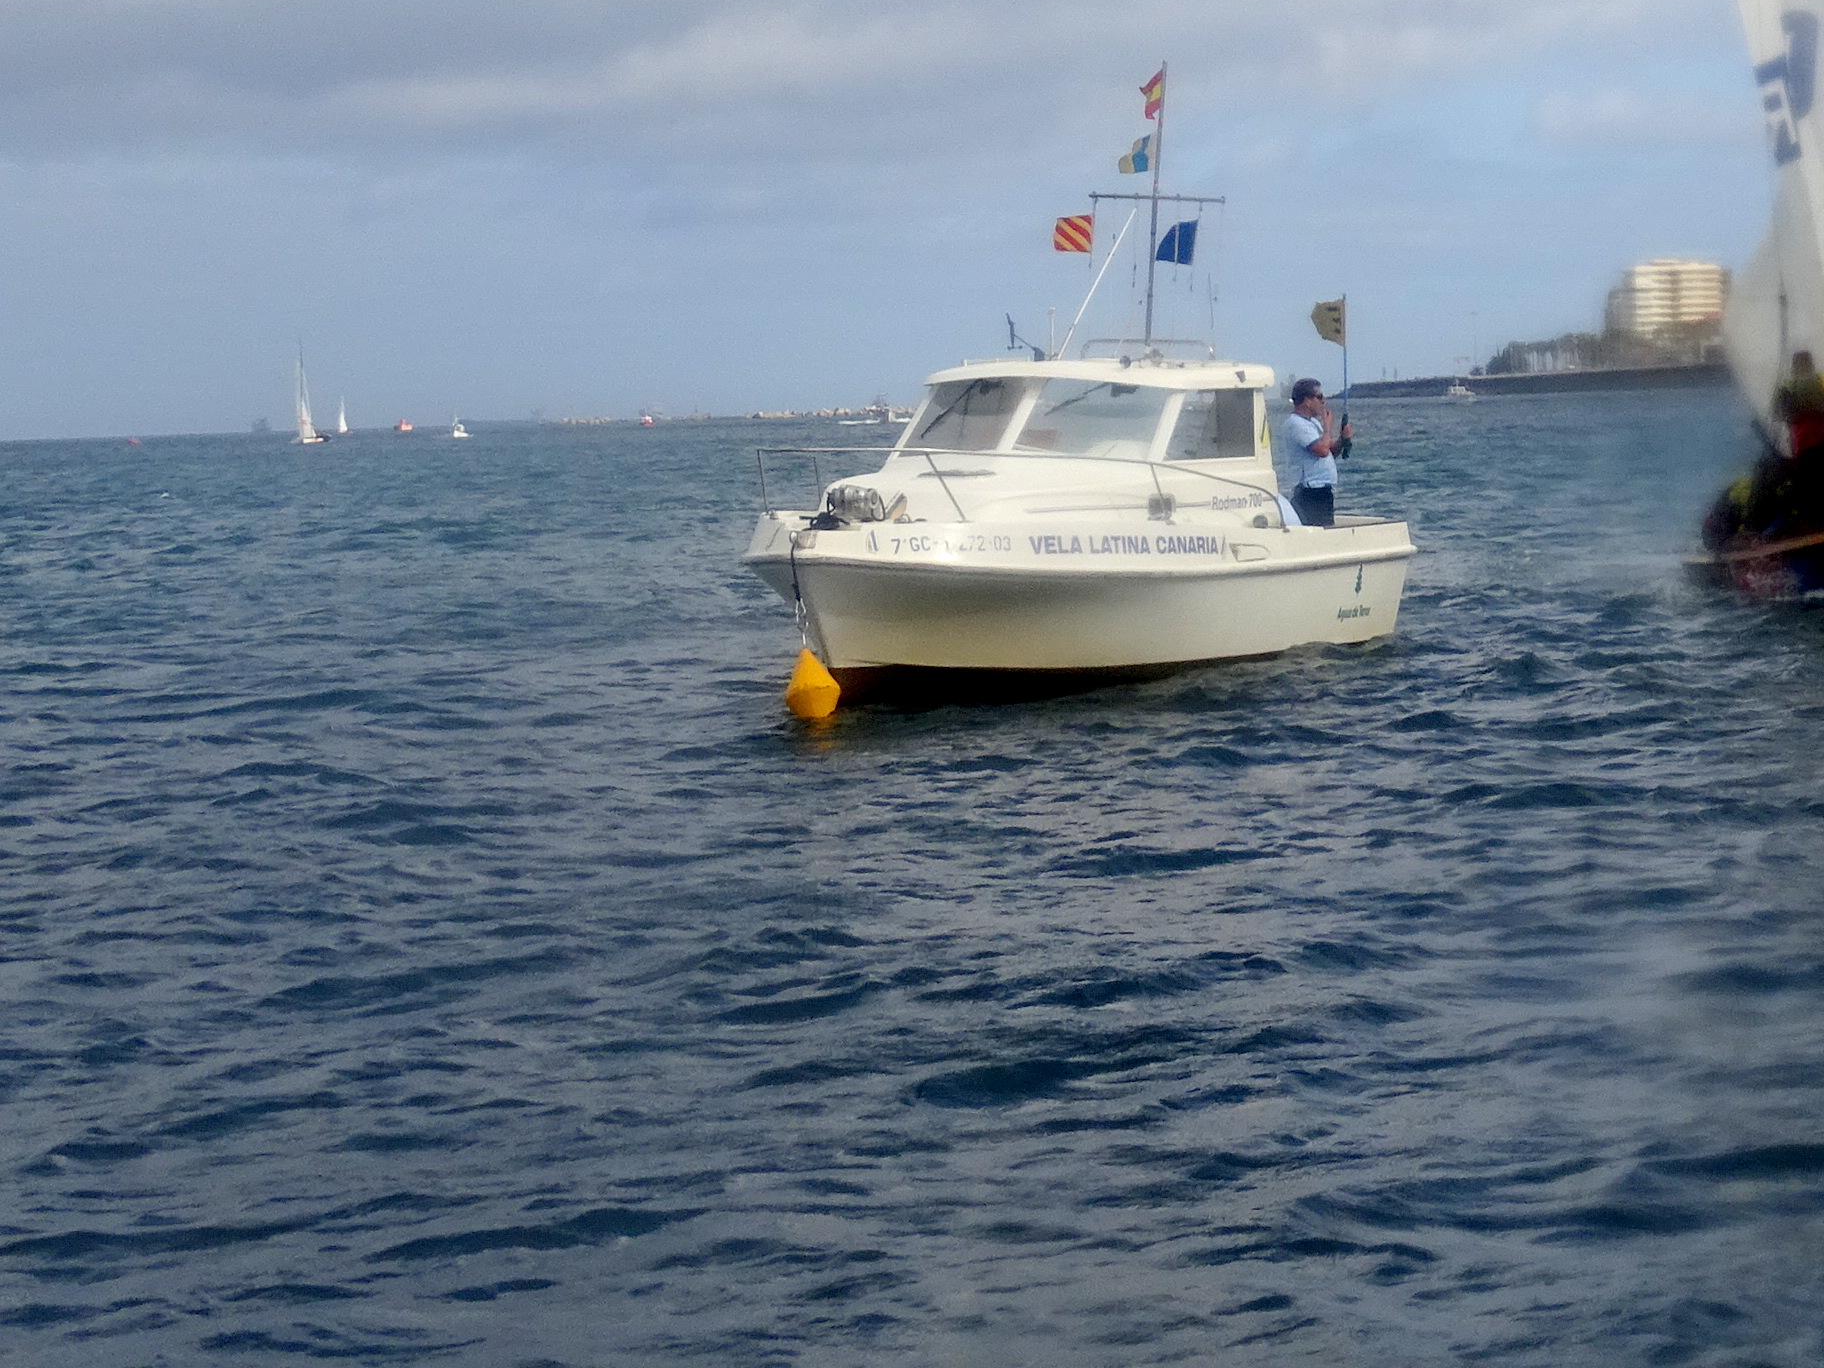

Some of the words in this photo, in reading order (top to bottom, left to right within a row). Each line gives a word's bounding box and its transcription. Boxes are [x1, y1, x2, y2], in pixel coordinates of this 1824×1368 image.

[1029, 536, 1082, 554] VELA
[1089, 536, 1150, 554] LATINA
[1156, 536, 1218, 554] CANARIA
